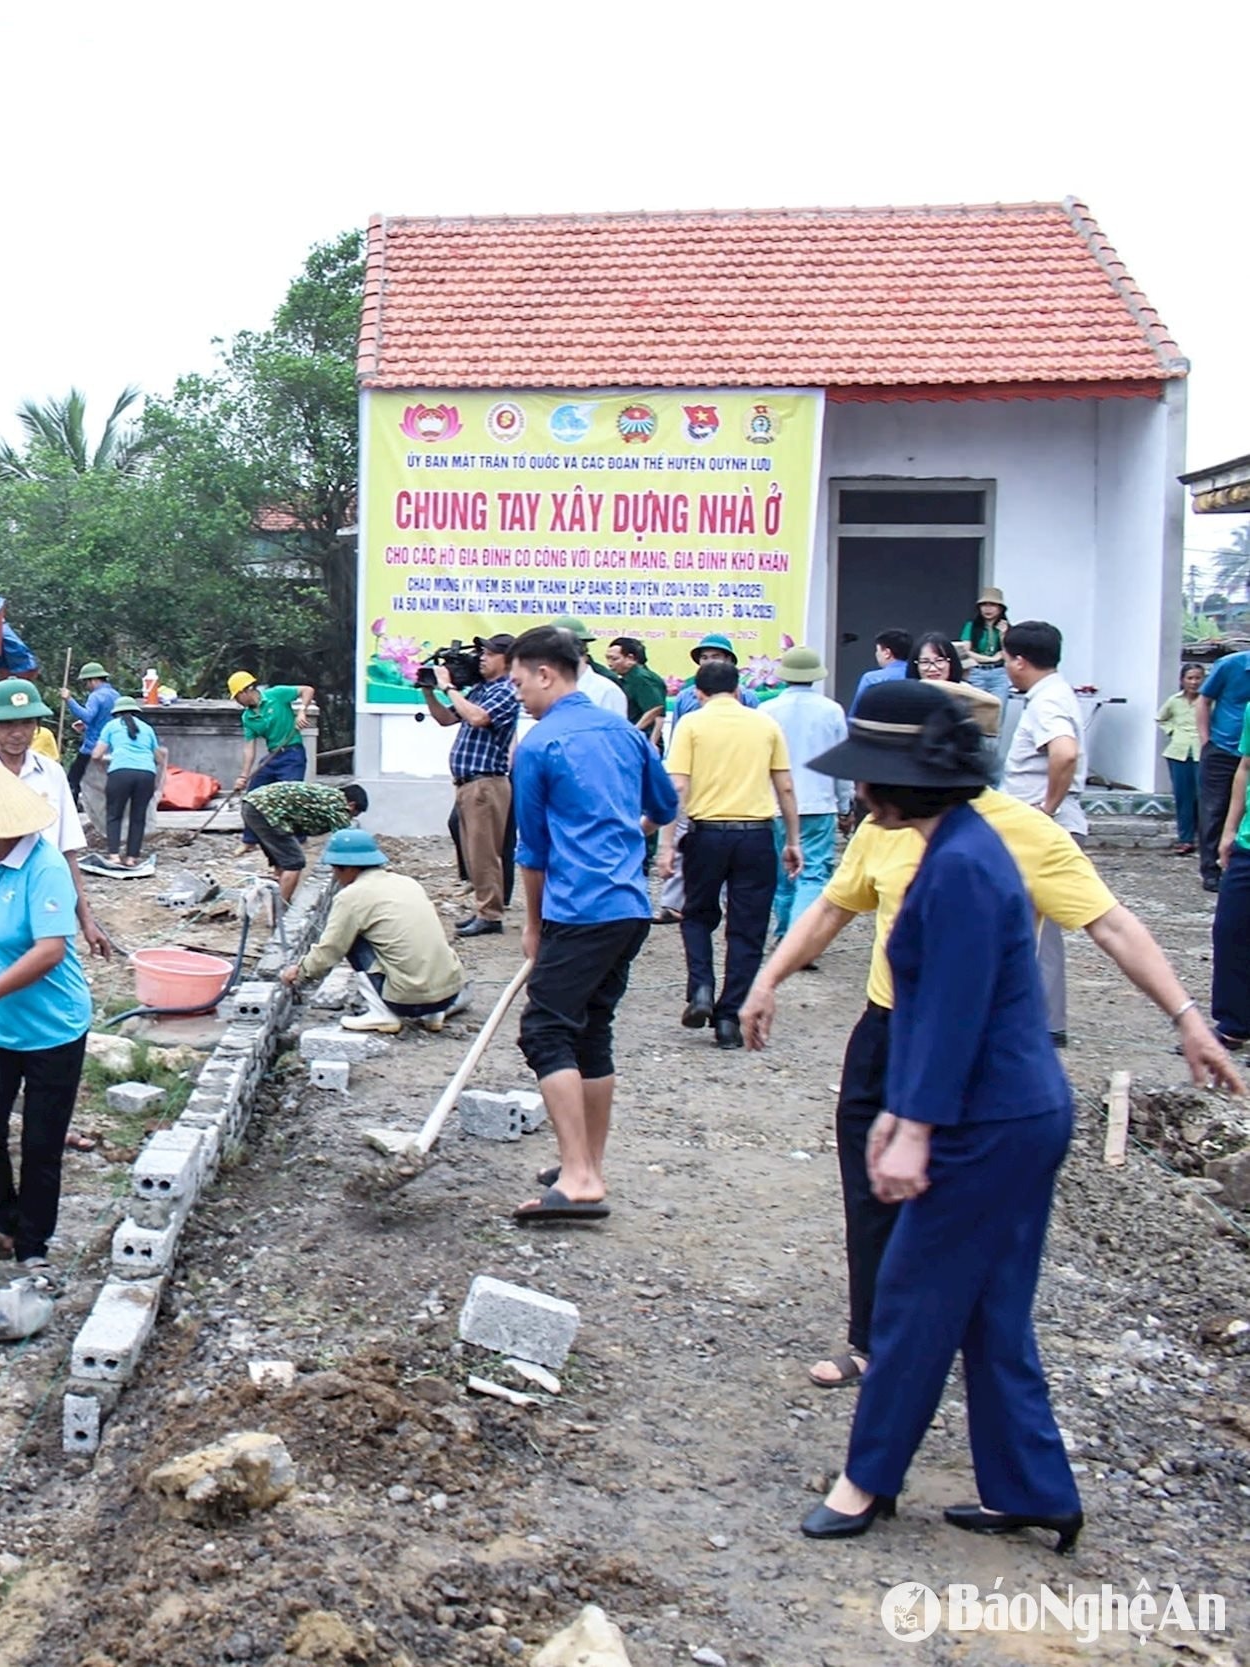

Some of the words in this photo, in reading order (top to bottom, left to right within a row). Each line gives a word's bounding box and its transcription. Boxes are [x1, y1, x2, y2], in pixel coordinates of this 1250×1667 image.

[425, 455, 448, 468] BAN
[396, 490, 488, 531] CHUNG
[497, 493, 541, 532] TAY
[550, 485, 603, 532] XÂY
[613, 490, 689, 542] DỰNG
[699, 486, 755, 535] NHÀ
[765, 482, 782, 536] Ở
[385, 546, 409, 565] CHO
[459, 547, 479, 566] GIA
[674, 551, 694, 569] GIA
